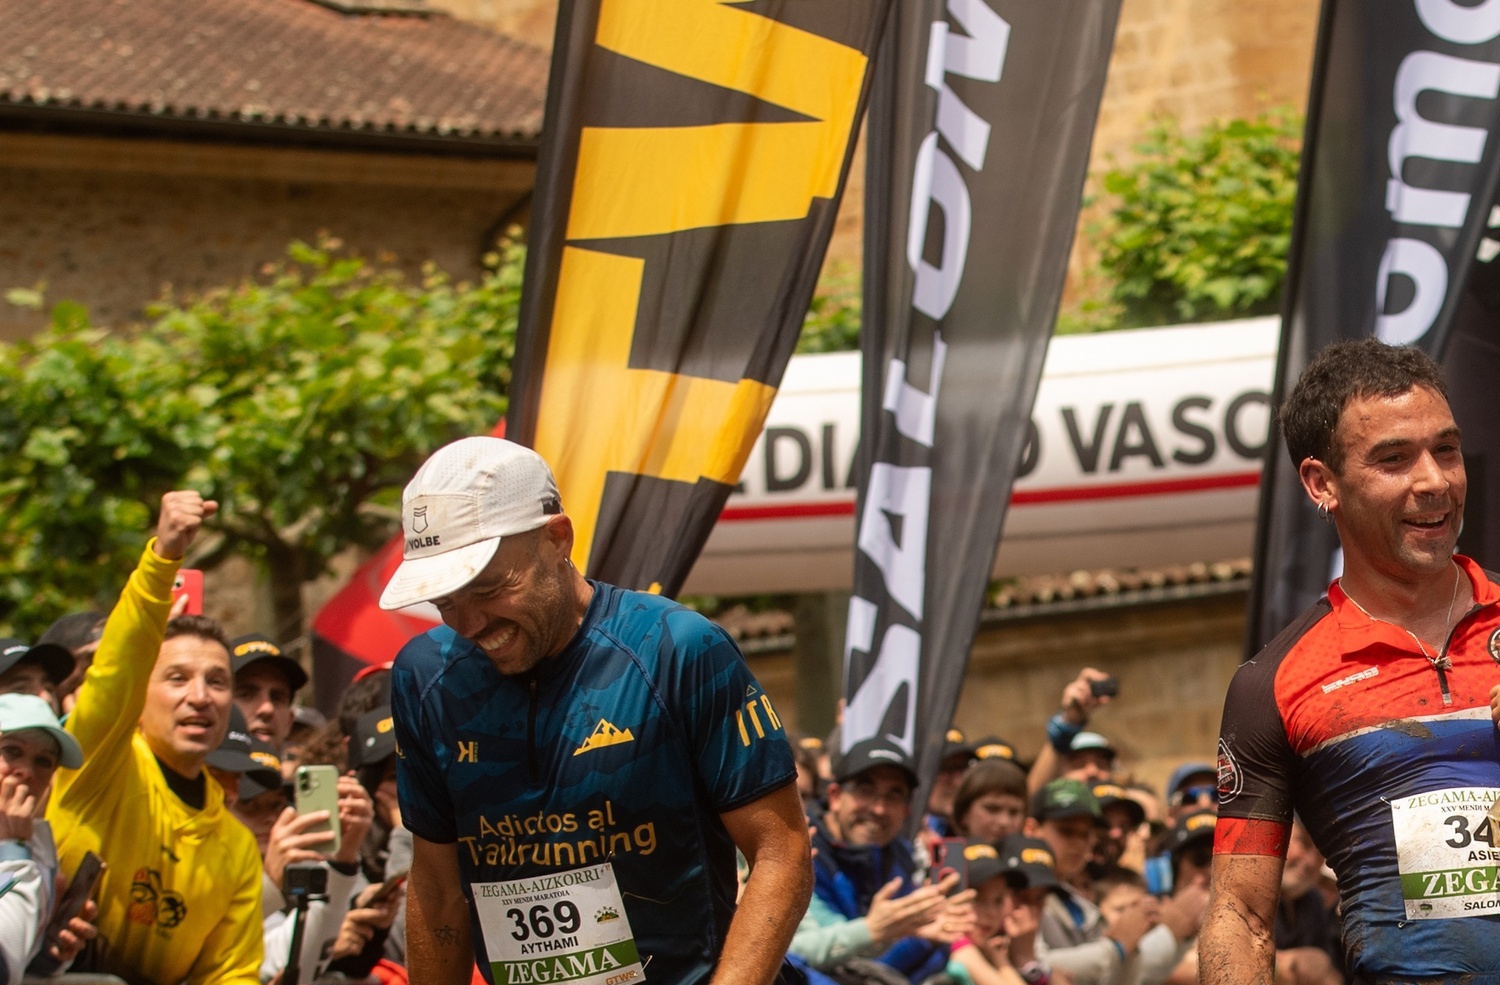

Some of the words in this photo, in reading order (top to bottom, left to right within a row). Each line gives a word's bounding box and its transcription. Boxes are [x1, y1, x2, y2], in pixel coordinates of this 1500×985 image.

[479, 810, 579, 839] Adictos
[587, 800, 616, 828] al
[1441, 804, 1458, 813] XXV
[1458, 804, 1483, 812] MENDI
[480, 868, 601, 898] ZEGAMA-AIZKORRI
[506, 900, 582, 942] 369
[521, 935, 580, 955] AYTHAMI
[504, 948, 622, 985] ZEGAMA
